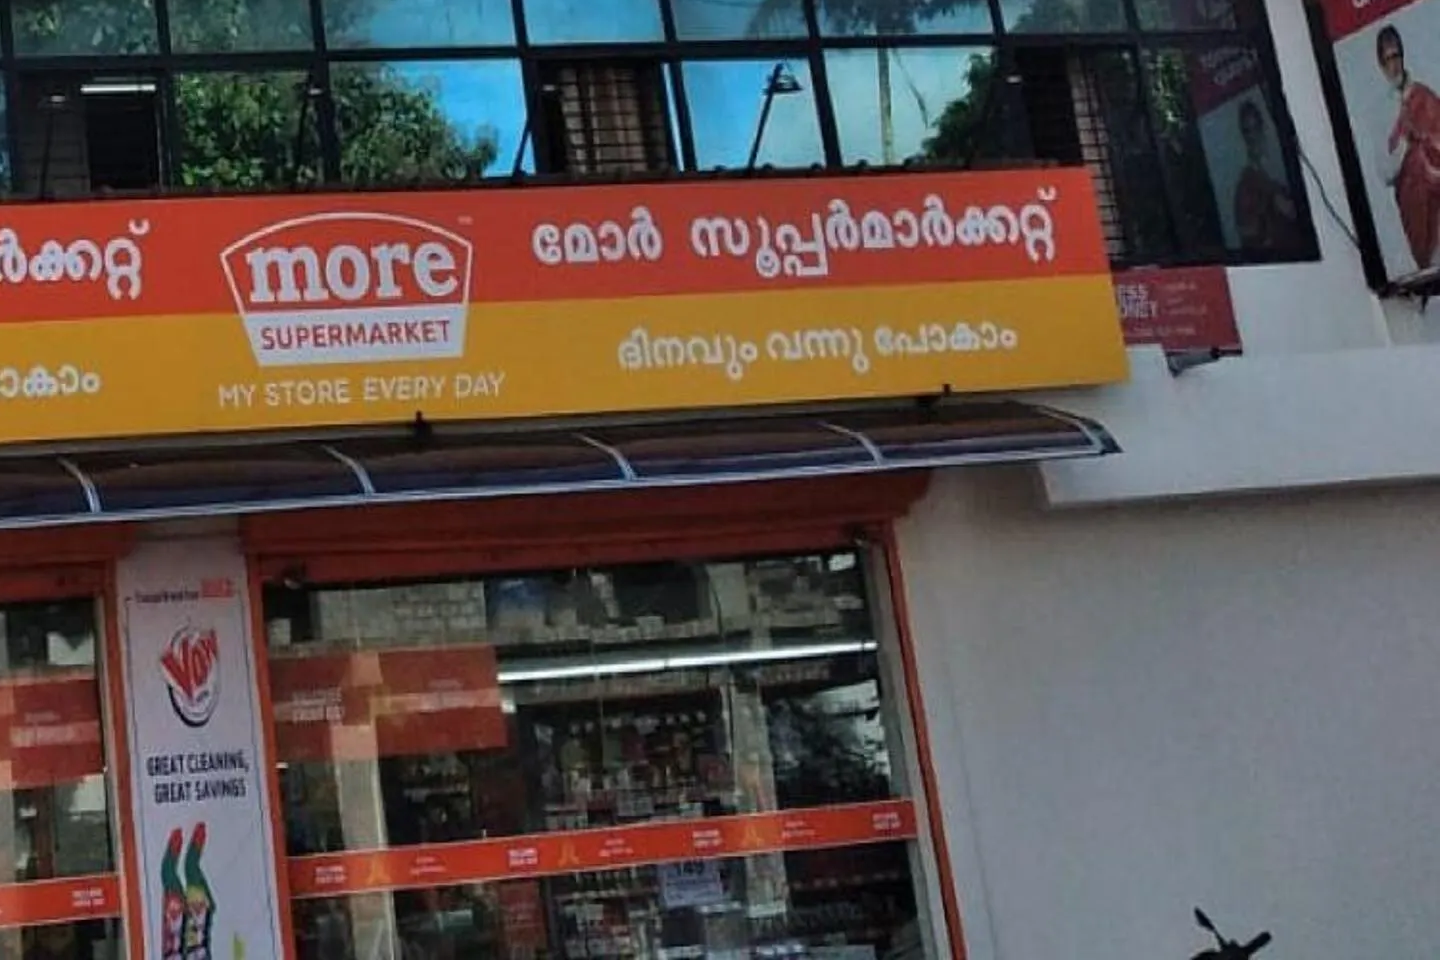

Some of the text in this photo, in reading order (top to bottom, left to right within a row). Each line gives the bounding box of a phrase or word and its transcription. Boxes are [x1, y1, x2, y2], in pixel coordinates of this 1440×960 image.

[533, 206, 663, 264] മോർ
[245, 241, 458, 303] more
[261, 320, 450, 351] SUPERMARKET
[618, 322, 1018, 379] ദിനവും വന്നു പോകാം
[219, 372, 506, 408] MY STORE EVERY DAY
[146, 753, 184, 776] GREAT
[155, 778, 246, 803] GREAT SAVINGS
